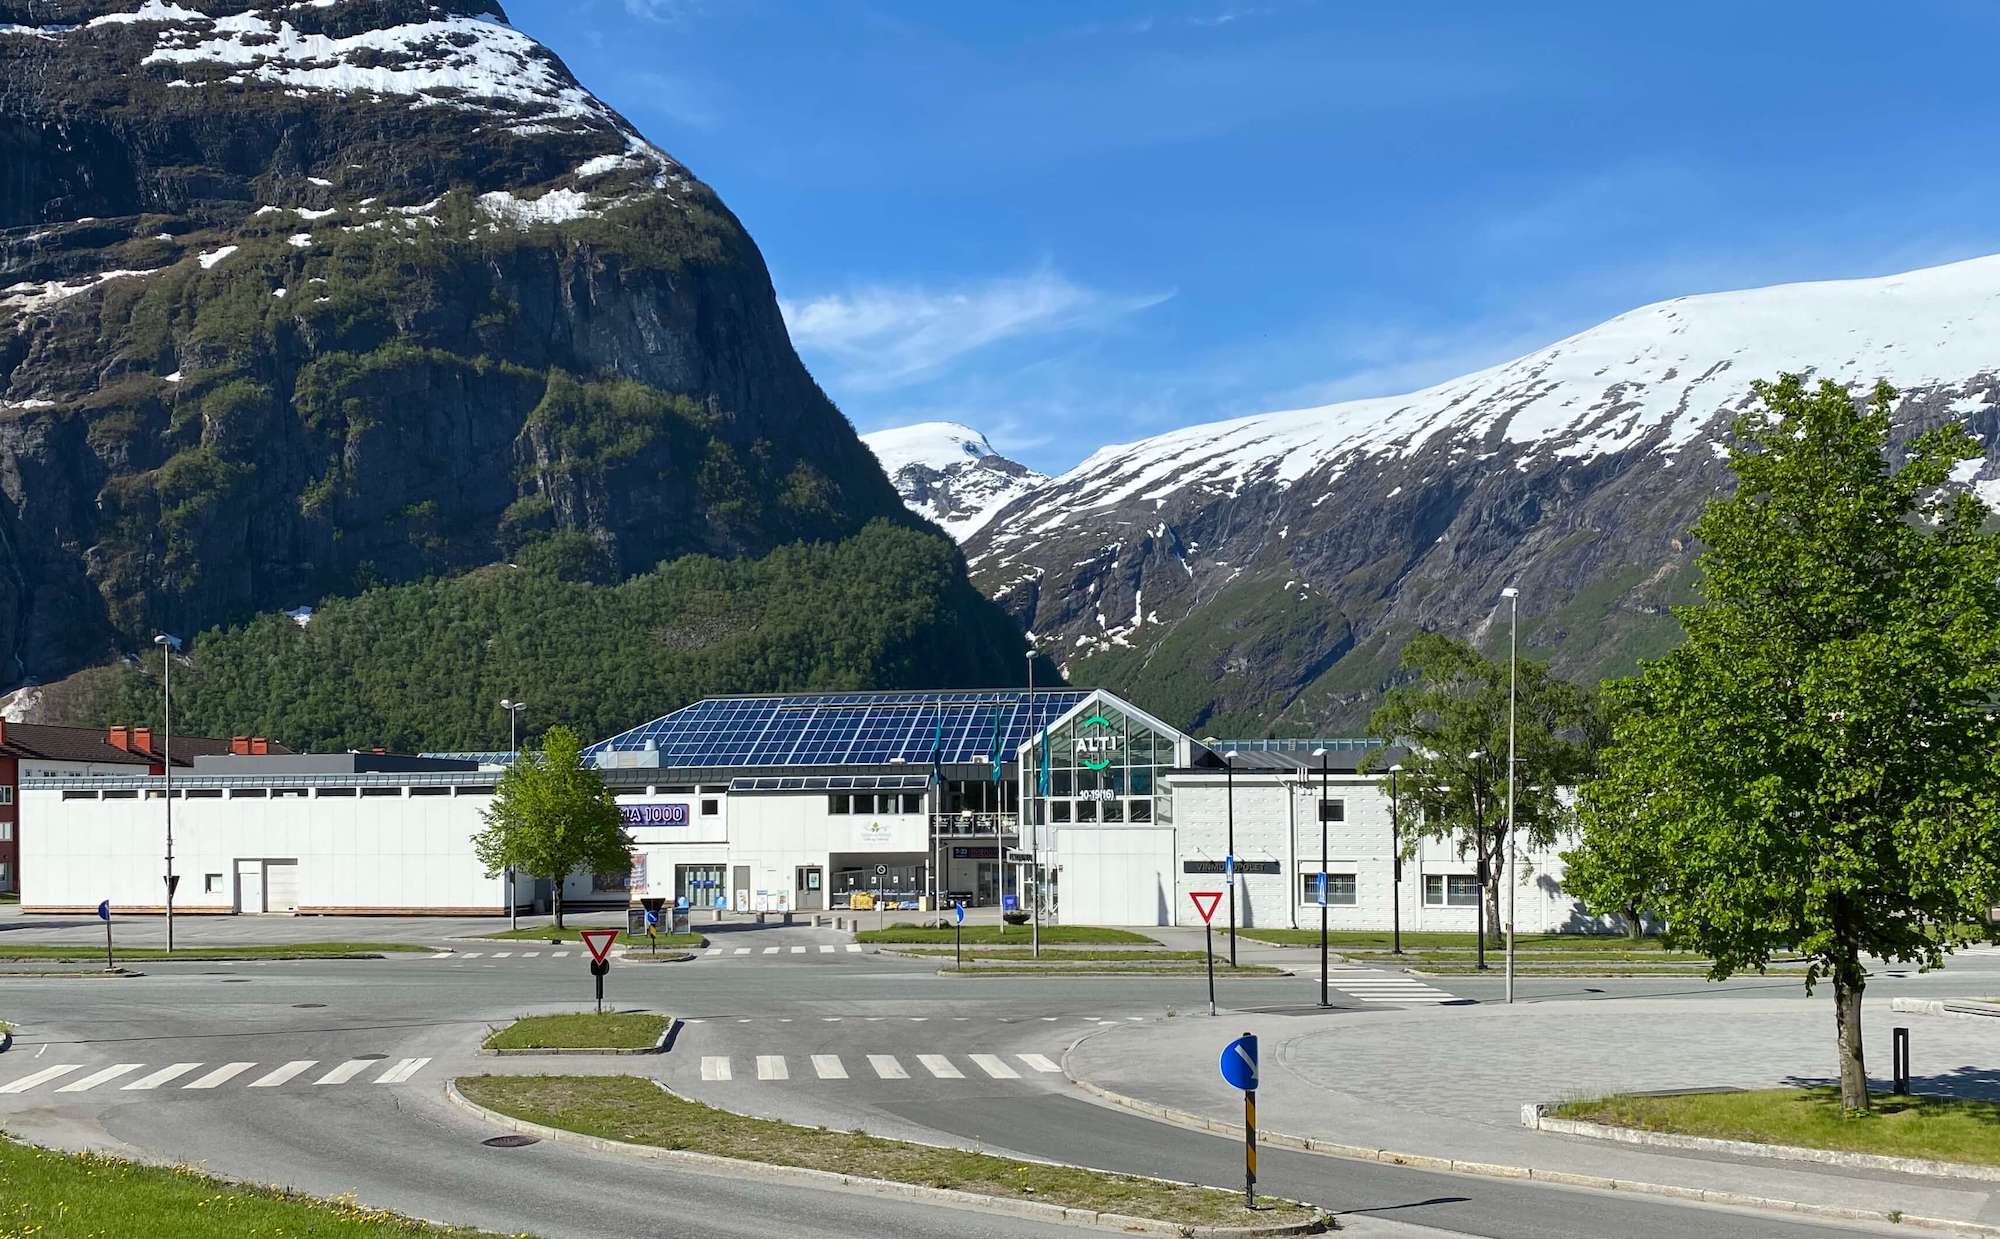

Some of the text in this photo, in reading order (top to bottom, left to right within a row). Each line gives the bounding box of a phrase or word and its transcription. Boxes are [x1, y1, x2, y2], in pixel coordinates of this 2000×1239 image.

[1076, 735, 1116, 751] ALTI
[1079, 788, 1114, 801] 10-19(16)
[645, 806, 682, 822] 1000
[1198, 863, 1265, 872] VINMOOPOLET
